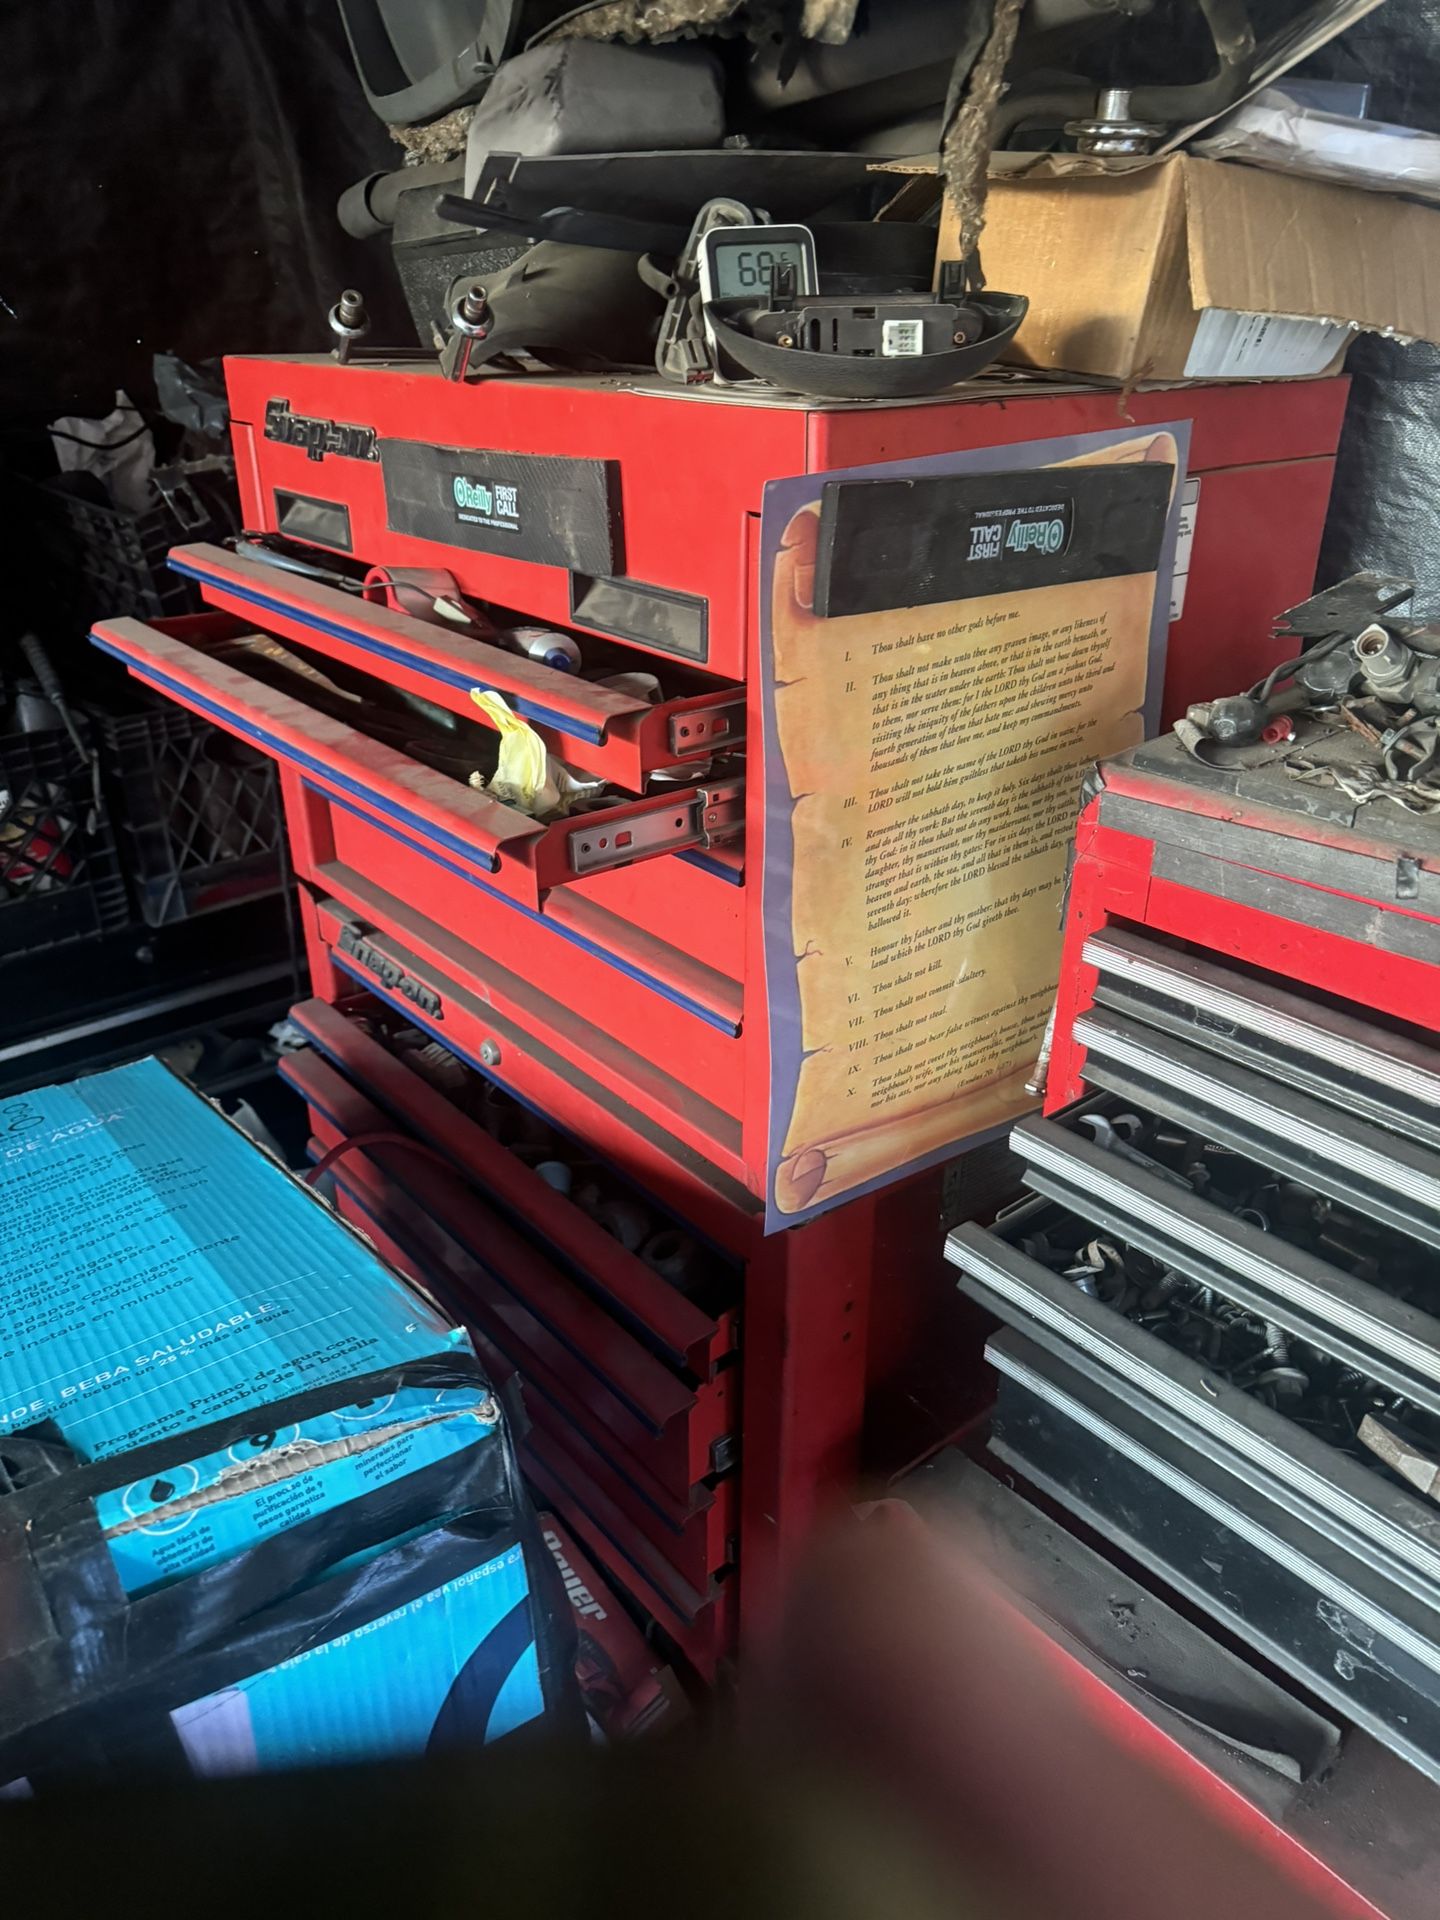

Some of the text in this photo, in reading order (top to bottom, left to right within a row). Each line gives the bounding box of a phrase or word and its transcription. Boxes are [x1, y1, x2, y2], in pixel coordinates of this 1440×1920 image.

[454, 476, 492, 516] O'Reilly
[494, 484, 518, 502] FIRST
[496, 500, 520, 518] CALL
[966, 542, 1000, 560] FIRST
[970, 524, 1002, 544] CALL
[1006, 519, 1064, 555] O'Reilly
[844, 650, 851, 662] I.
[871, 641, 893, 654] Thou
[895, 634, 914, 649] shalt
[916, 632, 934, 643] have
[936, 630, 946, 638] no
[947, 623, 967, 635] other
[967, 616, 983, 633] gods
[985, 612, 1006, 626] before
[845, 680, 856, 692] II.
[872, 672, 893, 685] Thou
[895, 664, 915, 679] shalt
[916, 662, 929, 673] not
[931, 655, 952, 669] make
[953, 652, 970, 663] unto
[972, 646, 987, 658] thee
[988, 644, 1002, 654] any
[1002, 637, 1026, 652] graven
[872, 703, 889, 715] that
[890, 699, 898, 710] is
[899, 696, 909, 707] in
[910, 692, 923, 704] the
[925, 687, 947, 700] water
[948, 679, 971, 693] under
[972, 675, 984, 686] the
[984, 668, 1006, 682] earth:
[1007, 664, 1025, 676] Thou
[843, 796, 857, 808] III.
[868, 787, 889, 799] Thou
[890, 778, 909, 792] shalt
[910, 775, 923, 785] not
[924, 768, 941, 781] take
[942, 764, 954, 775] the
[955, 759, 976, 770] name
[977, 752, 986, 765] of
[985, 750, 997, 761] the
[998, 742, 1021, 757] LORD
[1022, 738, 1033, 749] thy
[867, 797, 893, 813] LORD
[894, 790, 911, 803] will
[911, 787, 924, 798] not
[925, 779, 942, 793] hold
[942, 776, 958, 788] him
[958, 767, 988, 785] guiltless
[989, 761, 1005, 772] that
[1005, 752, 1027, 767] taketh
[1028, 750, 1038, 759] his
[845, 955, 852, 966] V.
[870, 940, 898, 956] Honour
[900, 934, 912, 944] thy
[913, 926, 936, 942] father
[937, 916, 952, 930] and
[953, 913, 964, 924] thy
[966, 904, 992, 919] mother:
[993, 897, 1008, 908] that
[1009, 892, 1020, 902] thy
[1021, 887, 1036, 897] days
[870, 954, 889, 969] land
[890, 945, 912, 961] which
[914, 942, 925, 952] the
[927, 931, 951, 947] LORD
[952, 926, 964, 937] thy
[965, 918, 981, 932] God
[981, 910, 1002, 928] giveth
[847, 992, 860, 1003] VI.
[872, 981, 892, 994] Thou
[894, 971, 912, 985] shalt
[914, 967, 926, 977] not
[848, 980, 954, 1028] VII. Thou shalt not commit
[847, 995, 1028, 1075] IX. Thou shalt not bear false witness against thy
[848, 1038, 868, 1051] VIII.
[873, 1030, 893, 1041] Thou
[895, 1019, 913, 1033] shalt
[915, 1015, 927, 1025] not
[21, 1276, 194, 1351] instala en minutos
[60, 1302, 281, 1398] BEBA SALUDABLE.
[83, 1375, 131, 1399] beben
[135, 1365, 155, 1376] un
[158, 1354, 178, 1367] 25
[198, 1333, 230, 1350] más
[232, 1324, 252, 1334] de
[254, 1308, 296, 1326] agua.
[94, 1335, 358, 1452] Programa de agua con
[201, 1336, 380, 1417] cambio de la botella
[354, 1434, 414, 1470] minerales para
[362, 1444, 413, 1478] perfeccionar
[386, 1458, 408, 1478] sabor
[256, 1474, 314, 1508] El de
[304, 1484, 317, 1494] de
[257, 1492, 326, 1530] pasos garantiza
[280, 1508, 311, 1528] calidad
